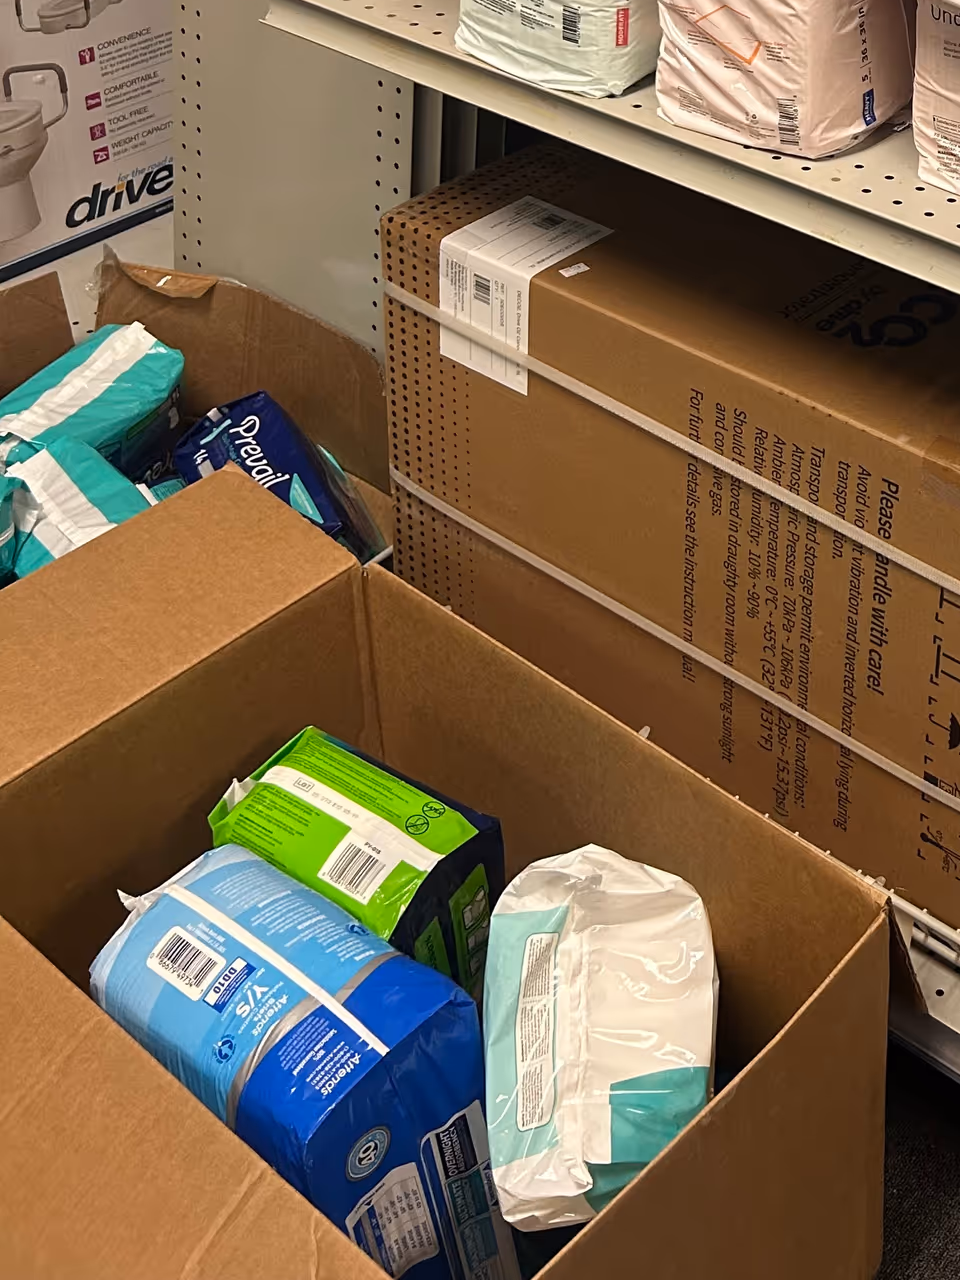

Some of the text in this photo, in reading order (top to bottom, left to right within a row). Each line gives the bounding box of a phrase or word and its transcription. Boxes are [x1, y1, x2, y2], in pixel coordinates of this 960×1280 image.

[97, 27, 151, 50] CONVENIENCE
[861, 48, 869, 63] 36
[104, 71, 159, 95] COMFORTABLE
[108, 106, 148, 125] TOOL FREE
[111, 131, 140, 149] WEIGHT
[118, 167, 145, 182] for the
[65, 164, 173, 228] drive
[229, 415, 290, 488] Prevail
[709, 403, 728, 516] and gas.
[683, 388, 704, 626] For details see the instruction
[748, 546, 762, 580] 10%
[718, 408, 747, 764] Should stored draughty room sunlight
[799, 542, 819, 640] storage permit
[867, 477, 899, 696] Please with care!
[779, 529, 800, 690] Pressure: 106kPa
[833, 464, 872, 832] Avoid vibration and inverted during
[213, 967, 237, 994] DD10
[235, 984, 270, 1018] Y/S
[252, 997, 276, 1022] Briefs
[252, 994, 288, 1036] Attends
[321, 1054, 361, 1096] Attends
